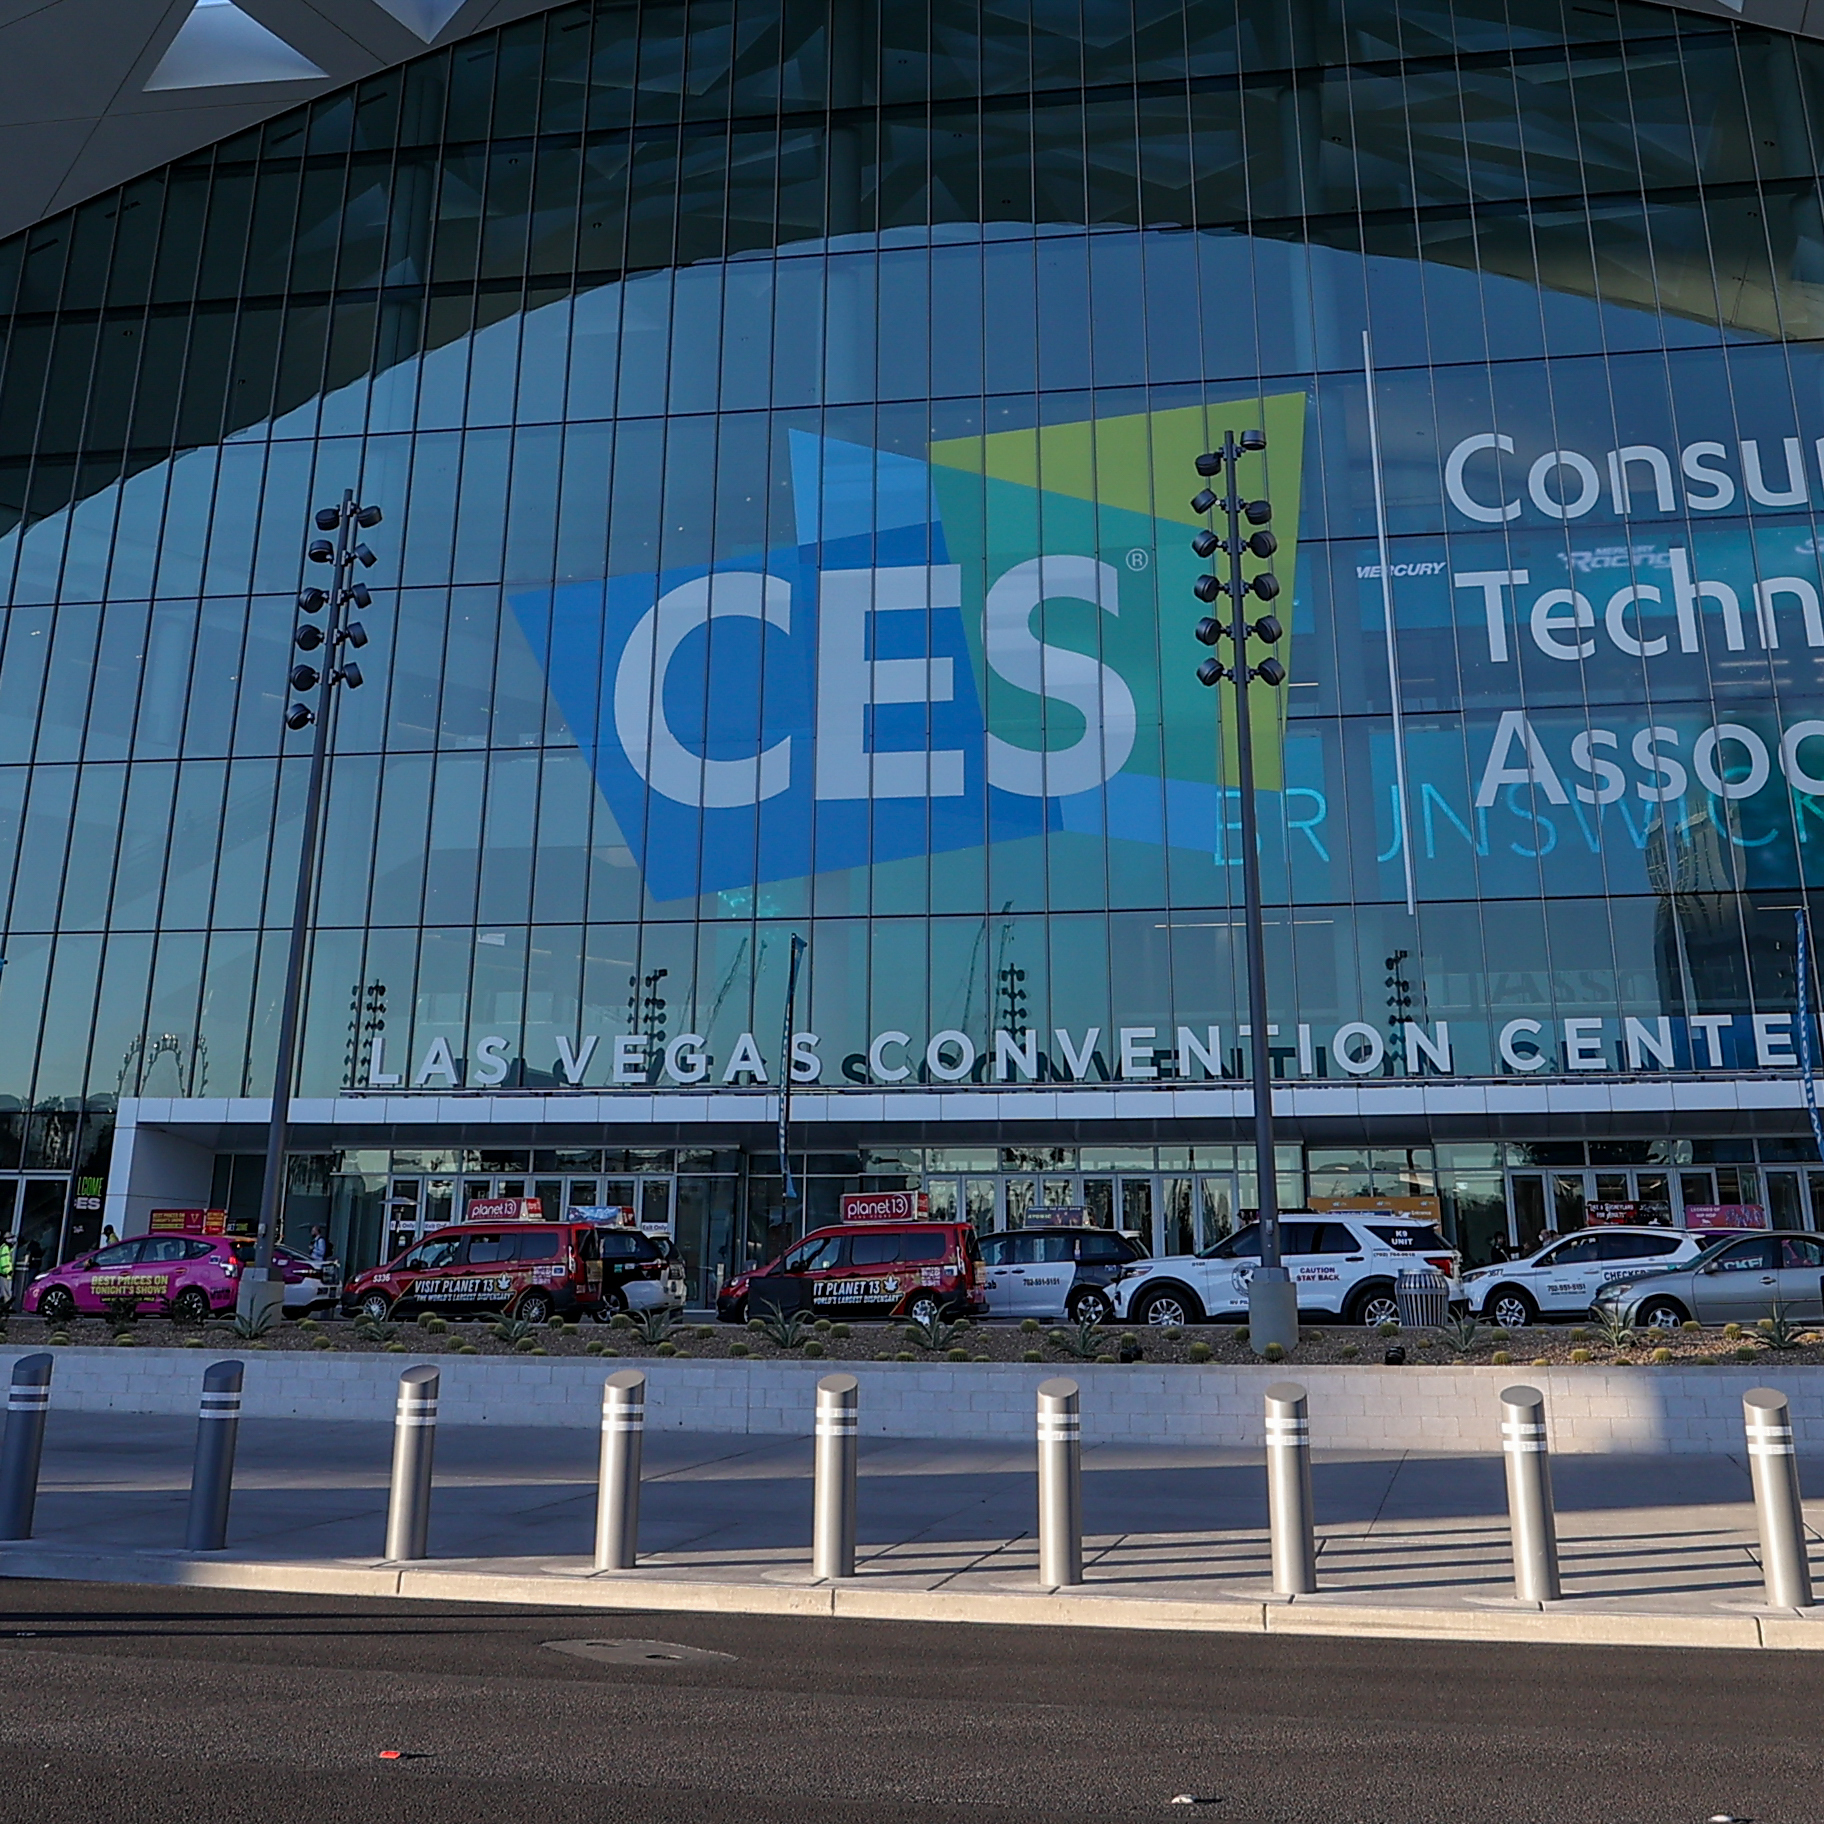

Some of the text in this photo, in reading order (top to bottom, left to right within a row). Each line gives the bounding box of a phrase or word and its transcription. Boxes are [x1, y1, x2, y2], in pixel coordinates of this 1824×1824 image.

[1355, 561, 1447, 580] MECURY
[368, 1035, 510, 1086] LAS
[555, 1030, 823, 1084] VEGAS
[77, 1176, 105, 1197] LCOME
[74, 1197, 101, 1211] ES
[1395, 1230, 1408, 1238] K9
[1391, 1238, 1414, 1246] UNIT
[1299, 1267, 1336, 1275] CAUTION
[91, 1275, 168, 1286] BEST PRICES ON
[1318, 1274, 1340, 1282] BACK
[90, 1284, 168, 1295] TONIGHT'S SHOWS
[414, 1279, 494, 1294] VISIT PLANET 13
[826, 1281, 867, 1296] PLANET
[869, 1280, 882, 1294] 13
